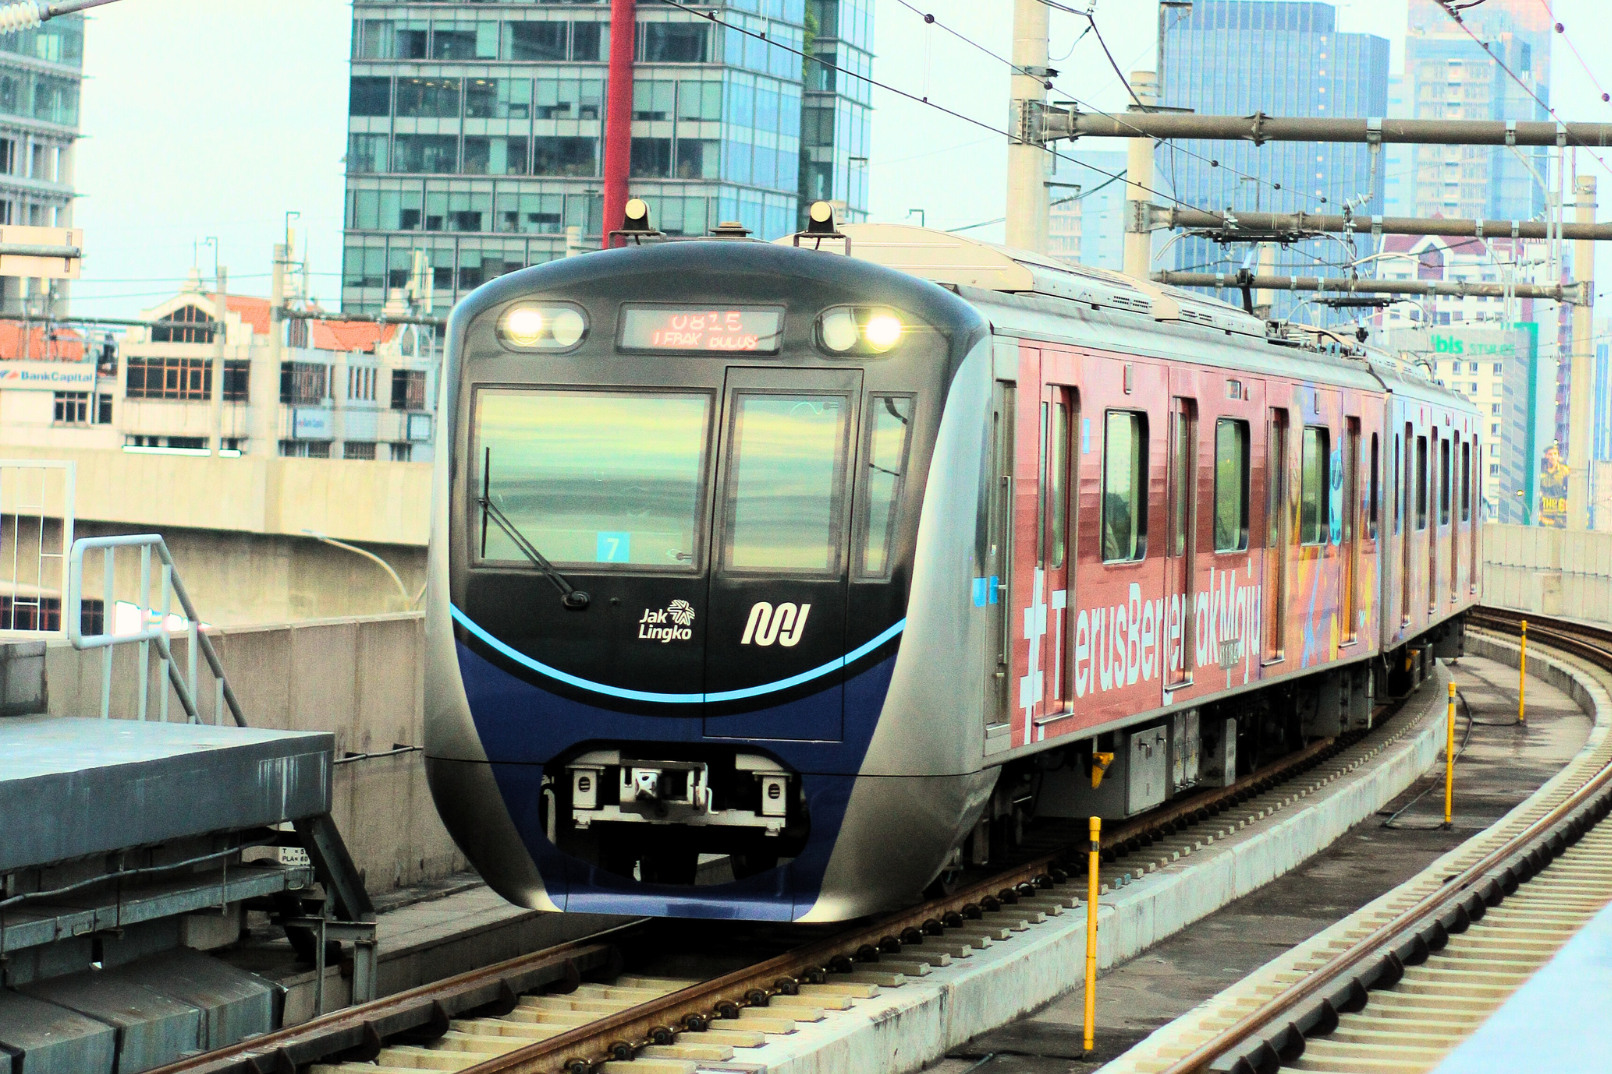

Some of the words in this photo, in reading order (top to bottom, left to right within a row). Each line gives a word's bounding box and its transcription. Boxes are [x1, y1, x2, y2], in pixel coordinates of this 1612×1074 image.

[606, 537, 620, 561] 7
[639, 608, 668, 624] Jak
[638, 624, 692, 643] Lingko
